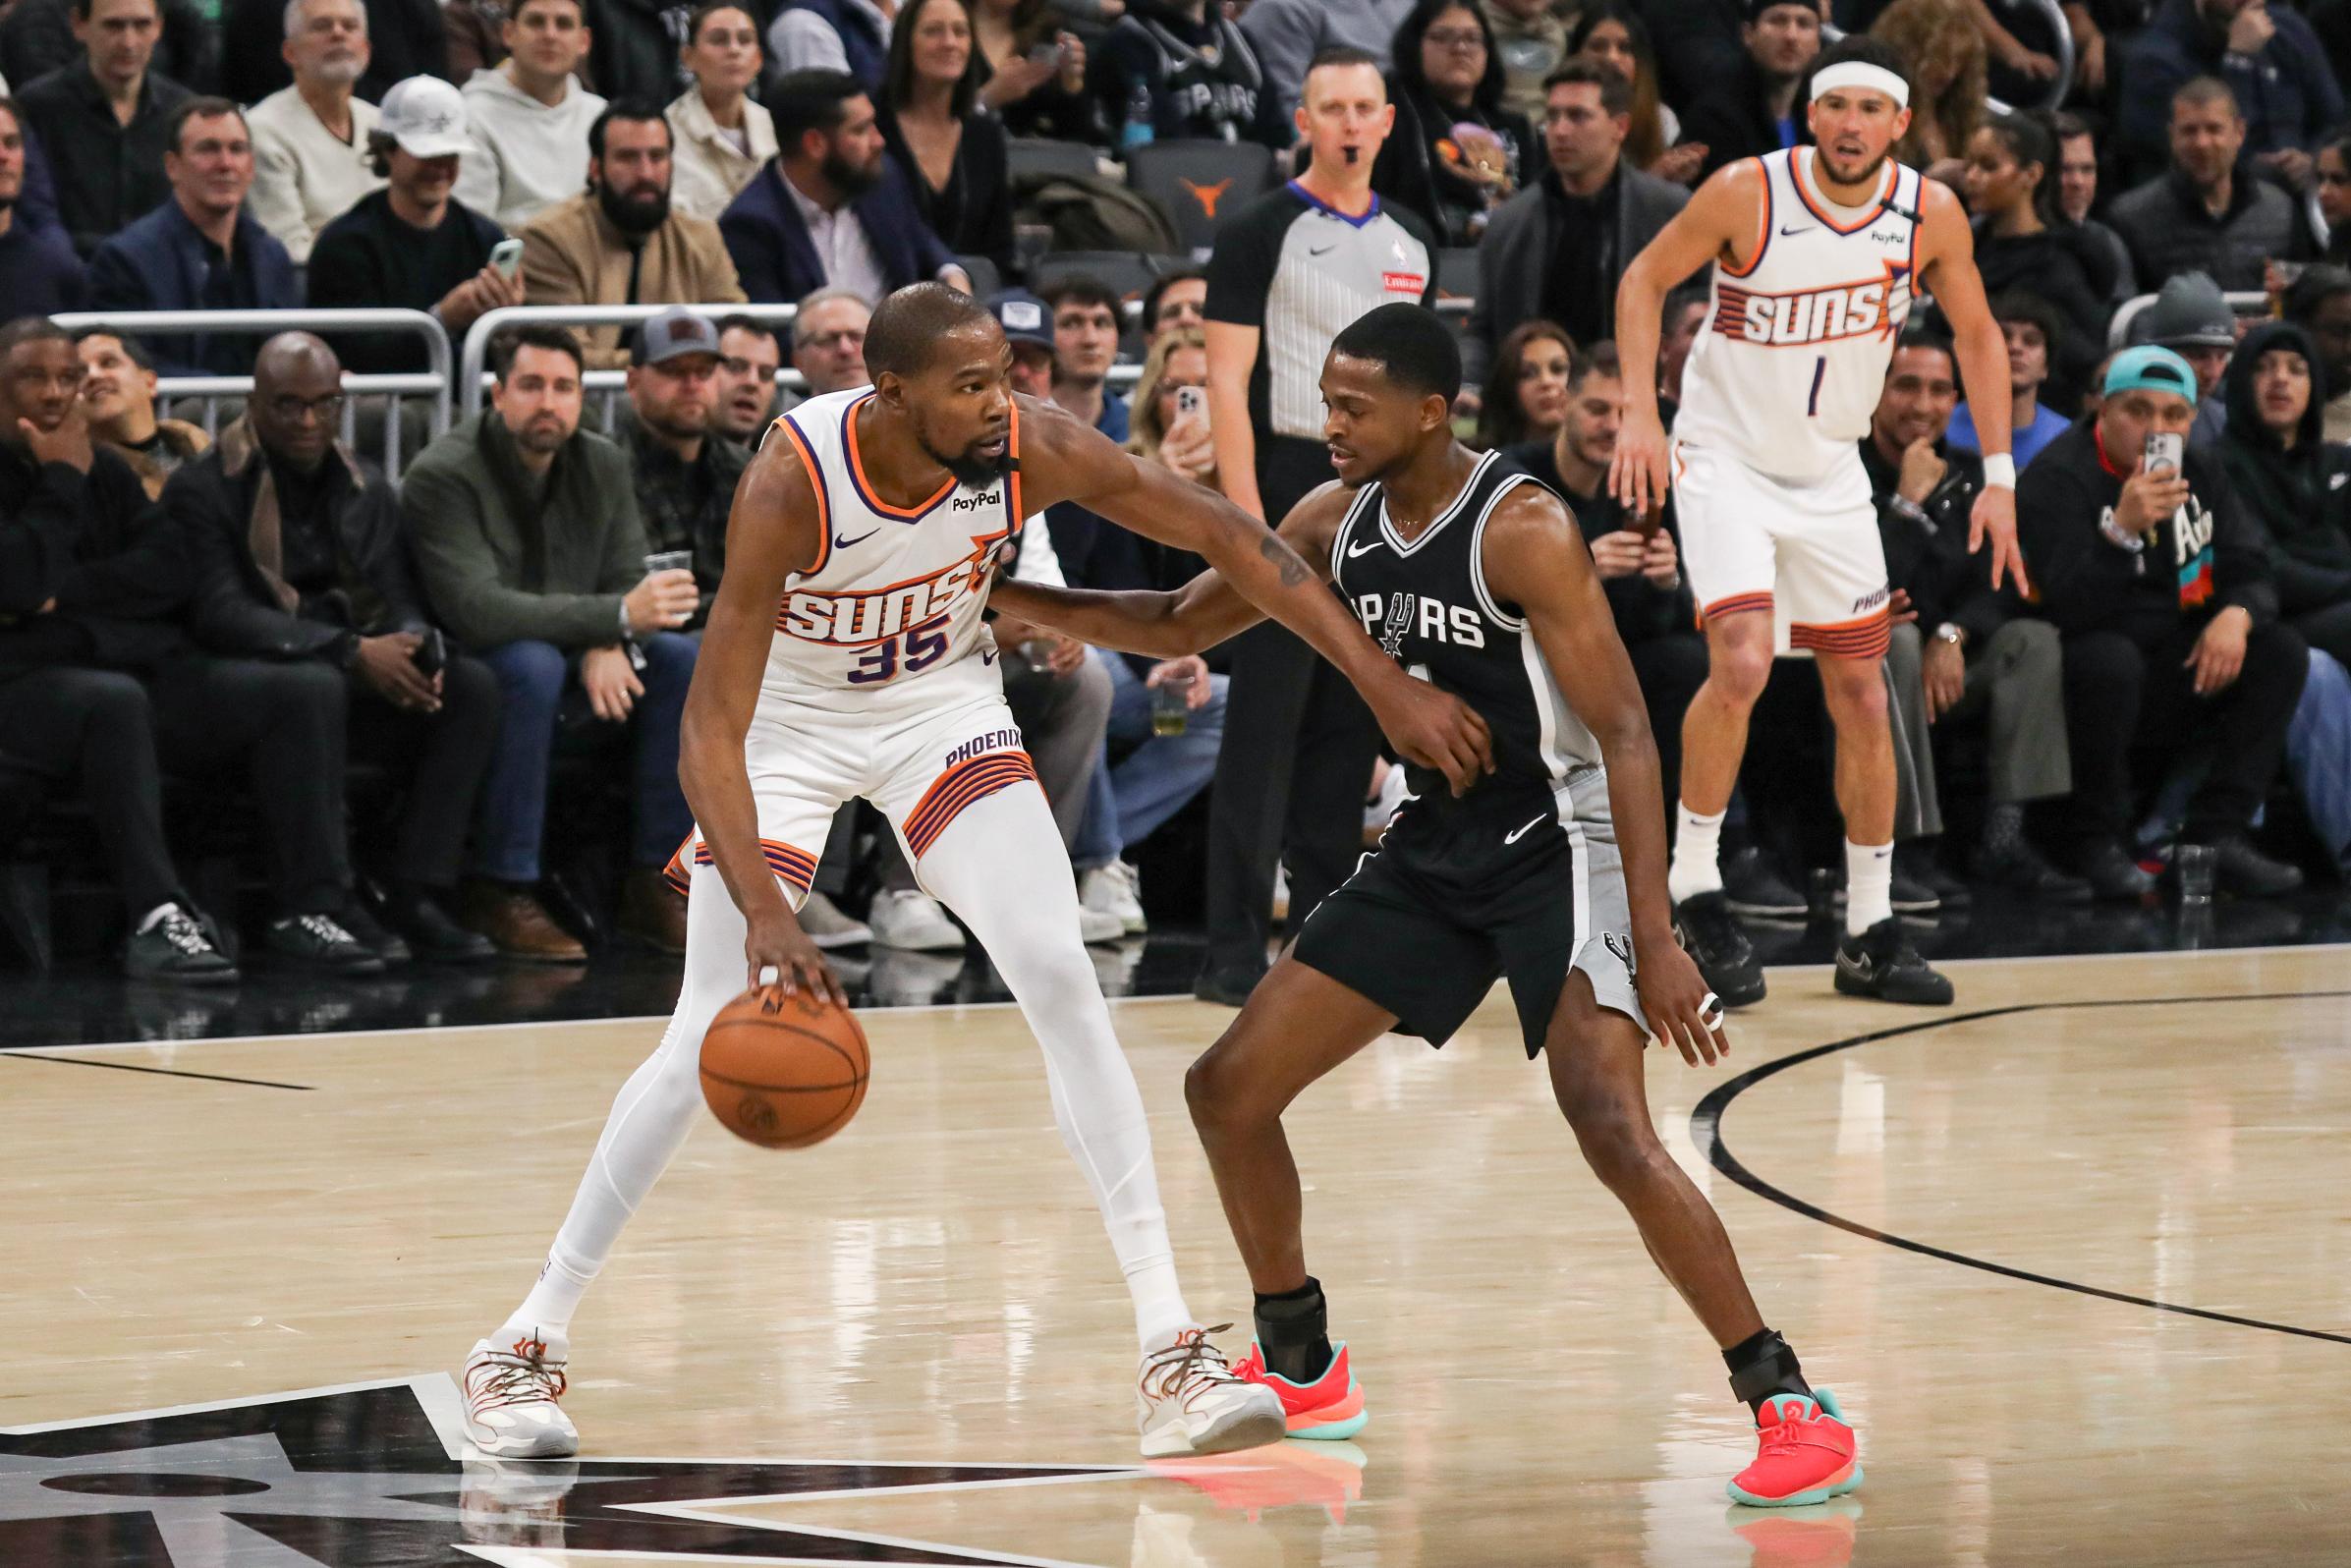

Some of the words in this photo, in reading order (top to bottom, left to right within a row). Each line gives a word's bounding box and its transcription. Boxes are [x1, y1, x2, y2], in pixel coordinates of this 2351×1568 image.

[1872, 231, 1905, 246] PayPal
[1808, 356, 1826, 417] 1
[953, 490, 1000, 511] PayPal
[848, 613, 953, 684] 35
[1351, 592, 1484, 656] PURS
[945, 728, 1021, 770] PHOENIX
